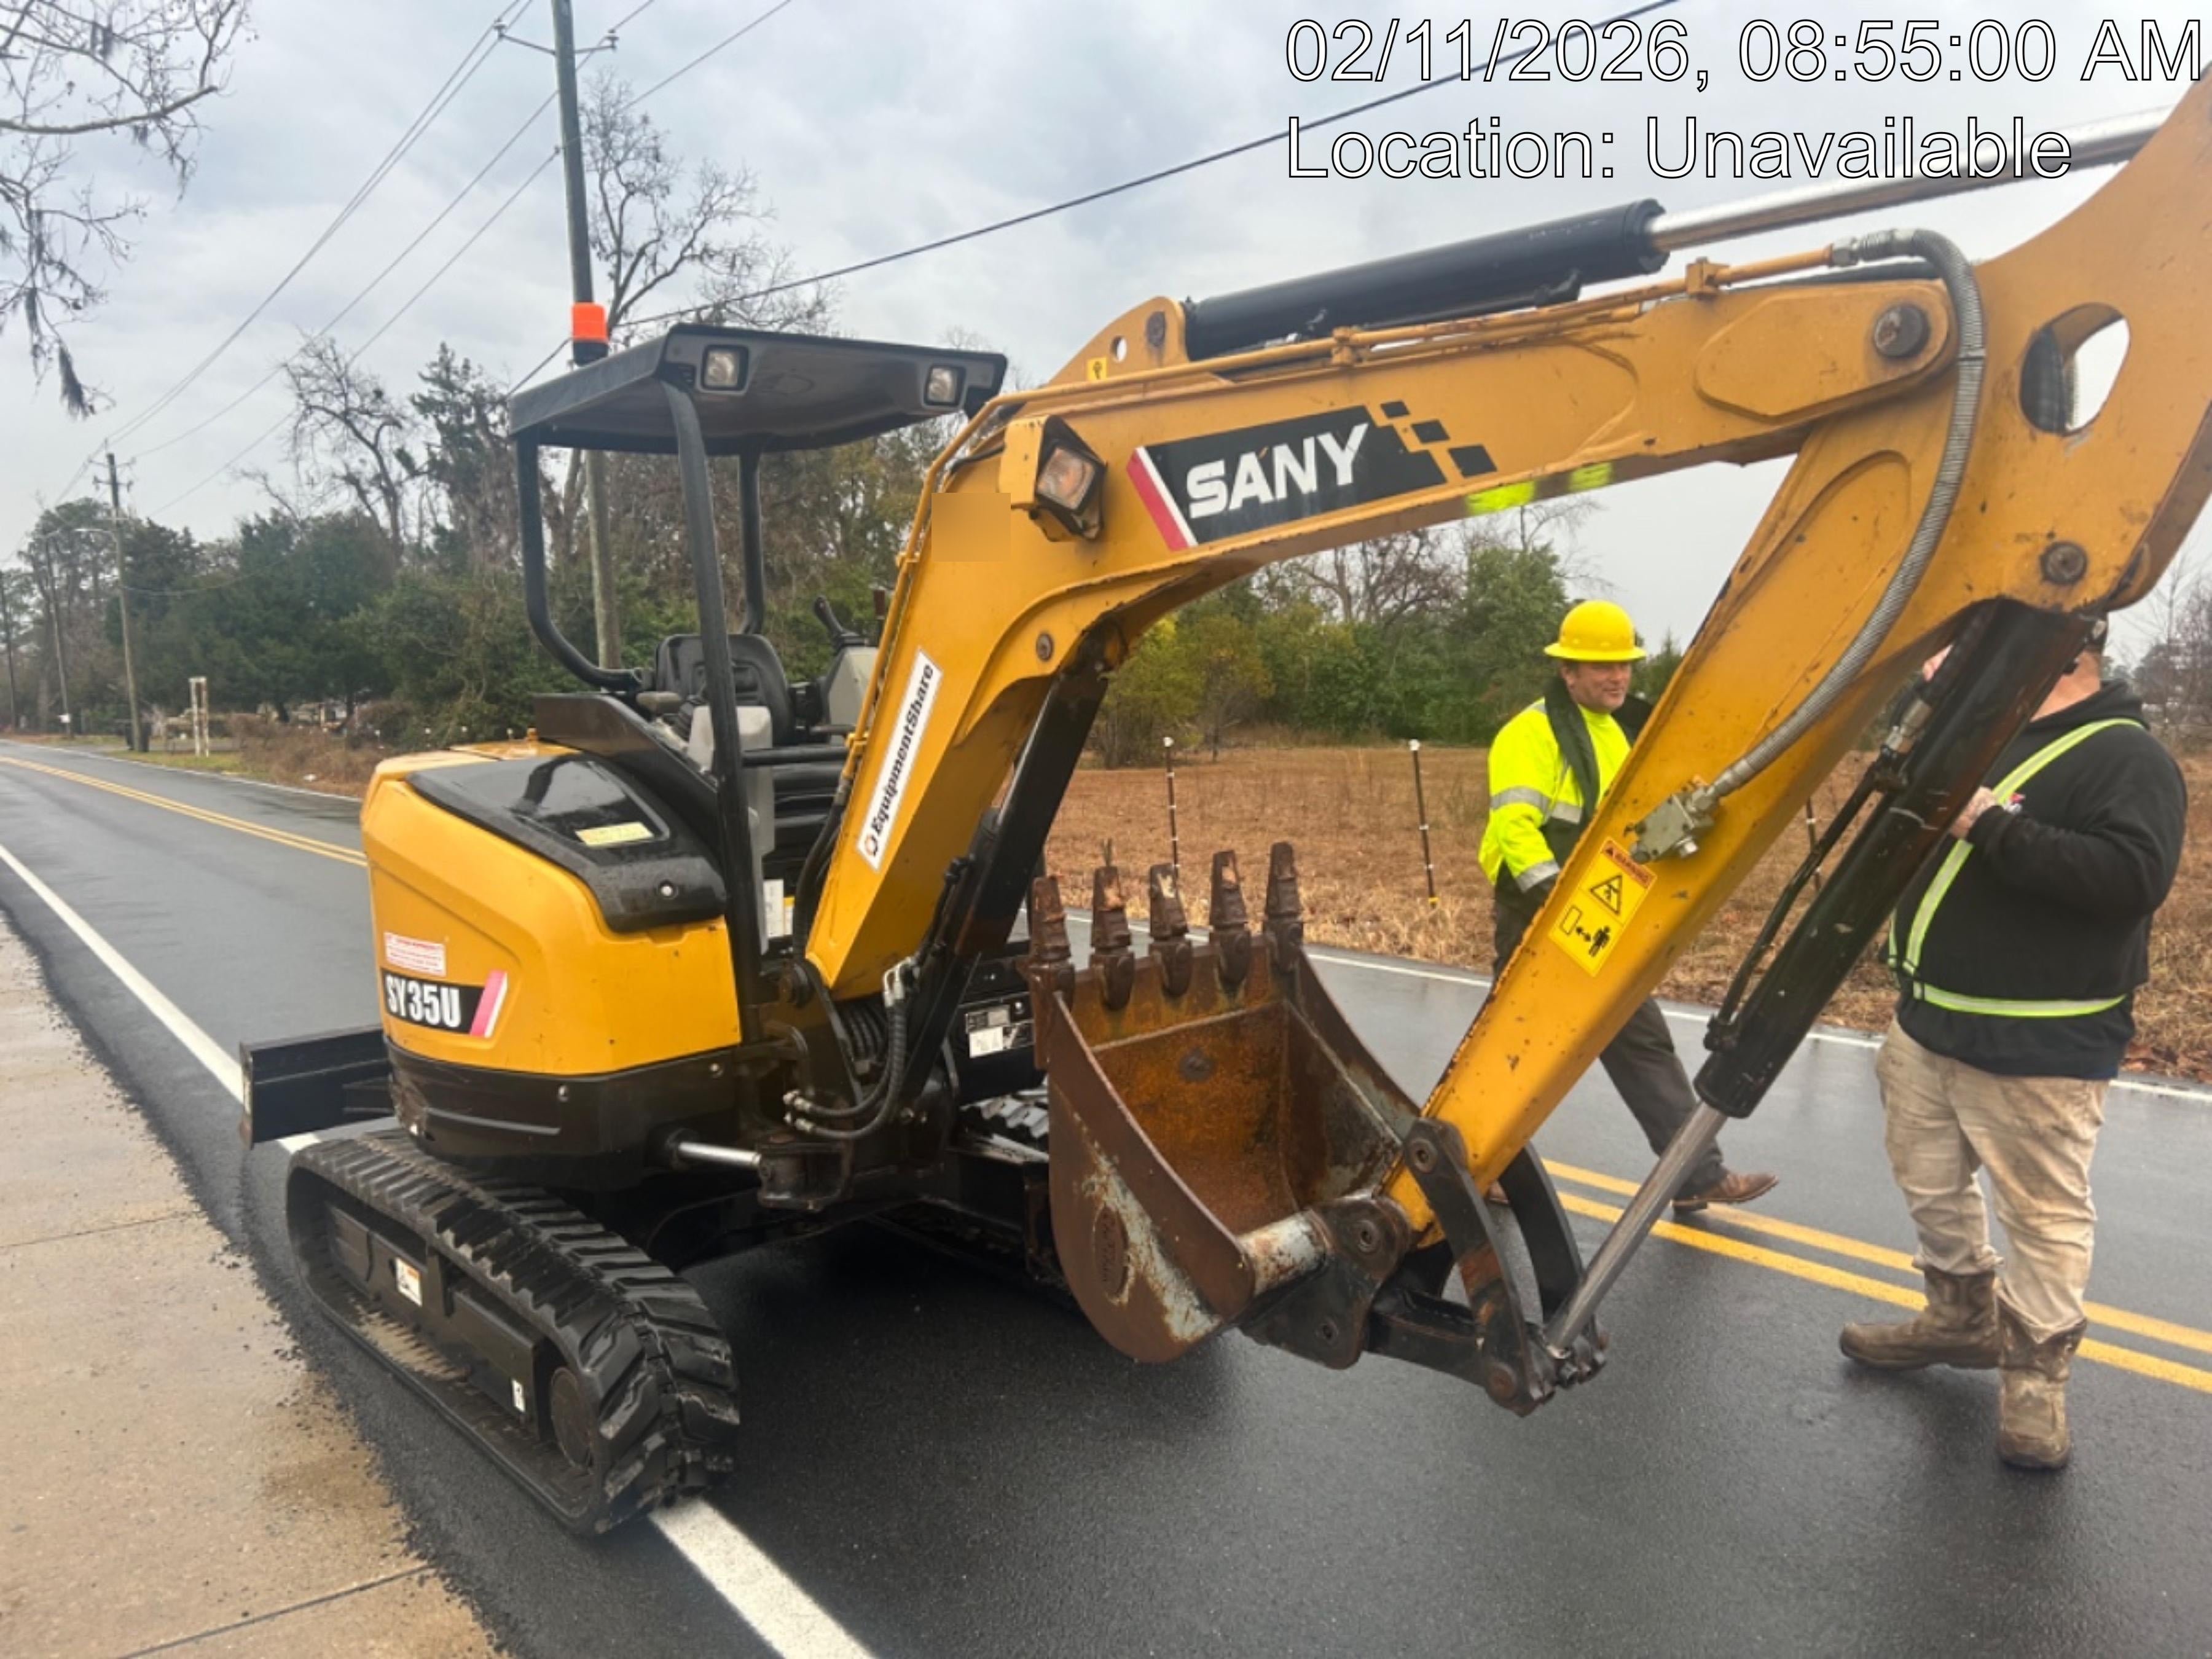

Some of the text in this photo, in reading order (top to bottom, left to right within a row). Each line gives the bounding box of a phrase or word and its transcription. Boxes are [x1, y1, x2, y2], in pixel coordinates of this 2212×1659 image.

[1186, 422, 1369, 519] SANY
[871, 664, 934, 834] EquipmentShare
[385, 974, 461, 1027] SY35U
